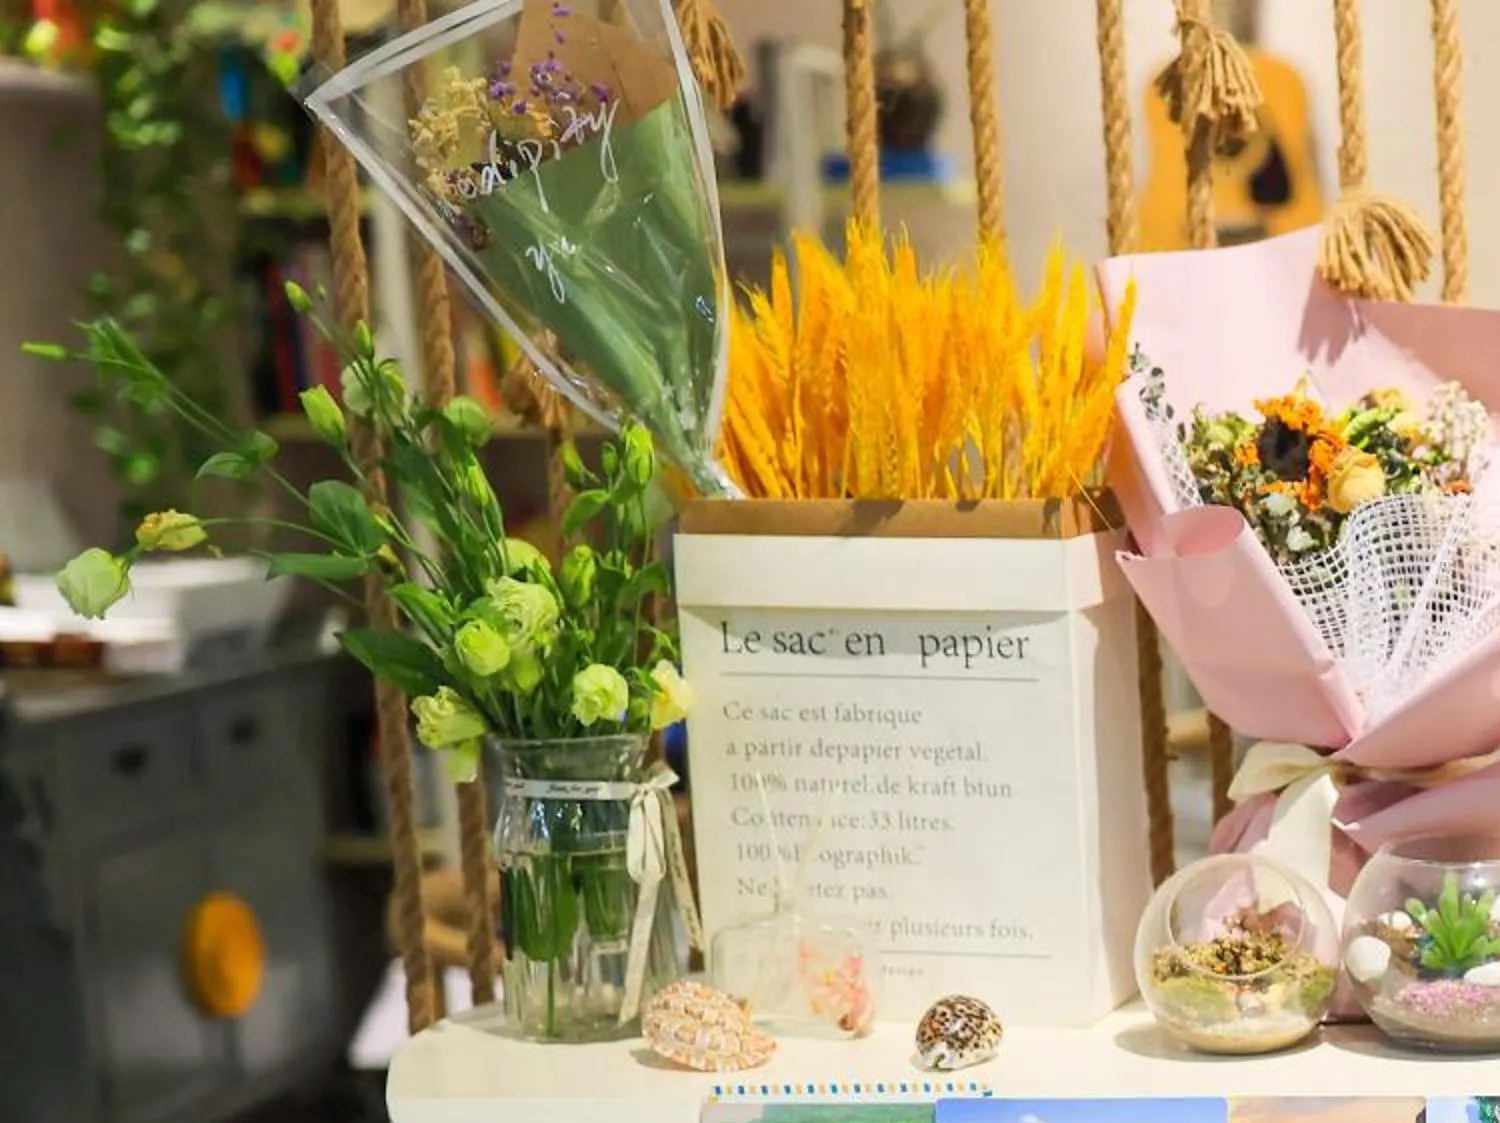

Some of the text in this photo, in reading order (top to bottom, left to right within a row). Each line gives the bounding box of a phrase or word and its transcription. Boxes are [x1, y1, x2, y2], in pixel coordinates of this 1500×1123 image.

[720, 620, 1030, 668] Le sac en papier
[723, 701, 922, 729] Ce sac est fabrique
[745, 739, 802, 762] partir
[908, 774, 956, 796] kraft
[737, 877, 767, 897] Ne
[890, 916, 984, 943] plusieurs
